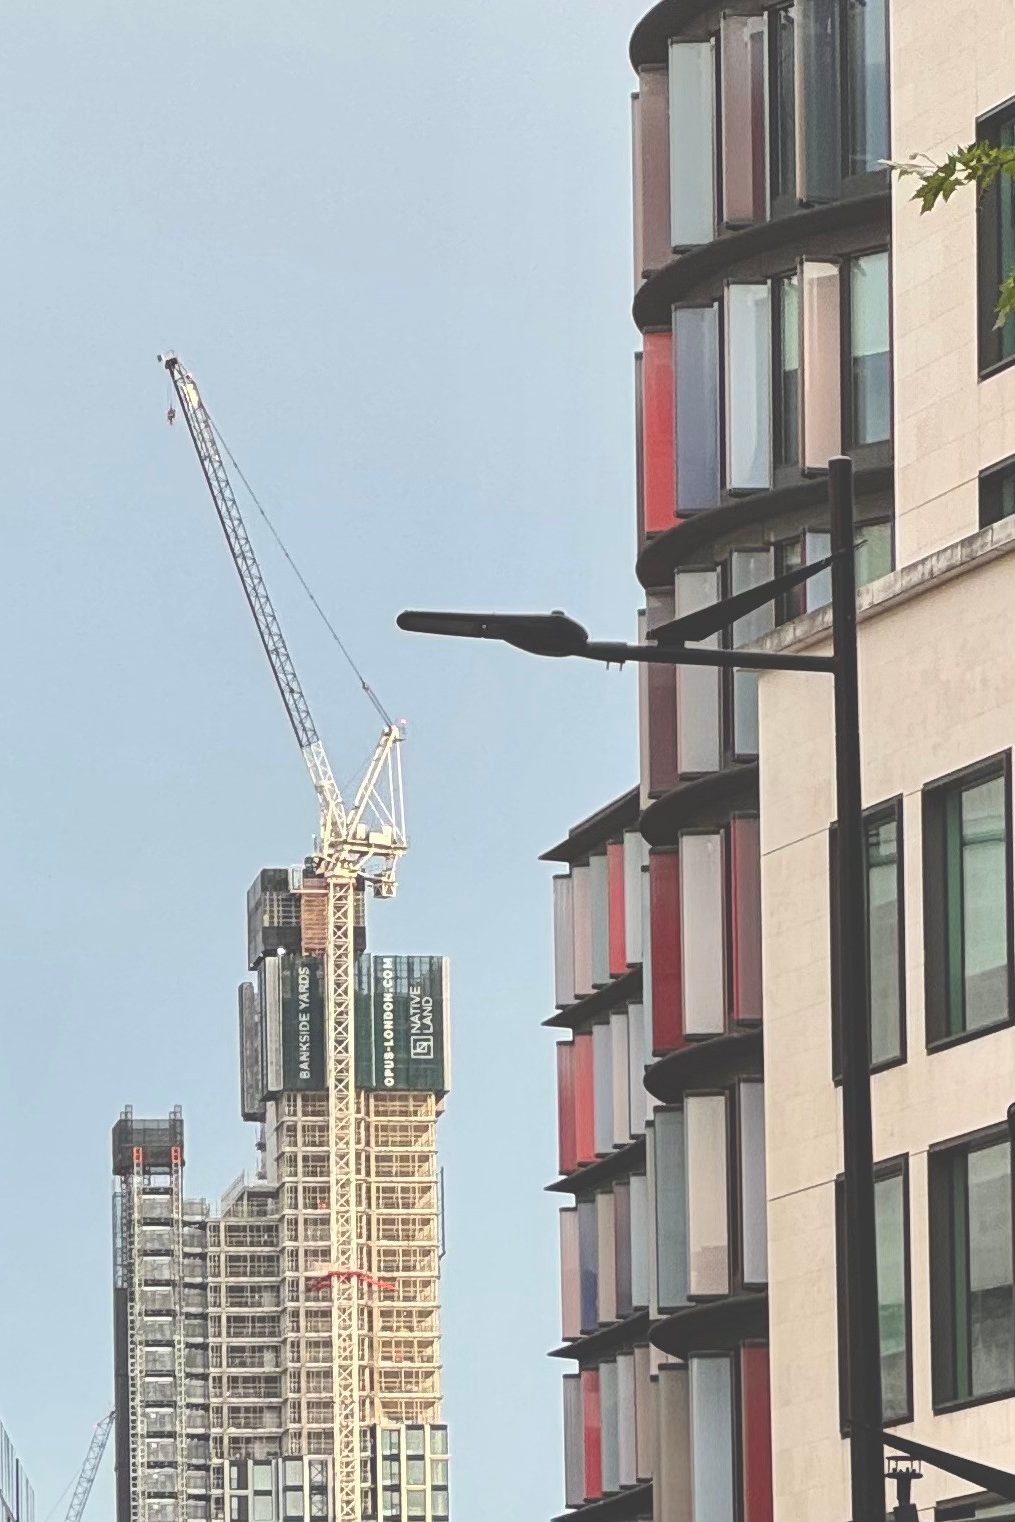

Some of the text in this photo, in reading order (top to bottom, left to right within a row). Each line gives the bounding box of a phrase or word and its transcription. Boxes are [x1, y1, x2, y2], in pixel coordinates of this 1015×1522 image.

[298, 966, 311, 1079] BANKSIDE YARDS
[382, 957, 395, 1087] OPUS-LONDON.COM
[409, 985, 422, 1034] NATIVE
[421, 996, 434, 1034] LAND
